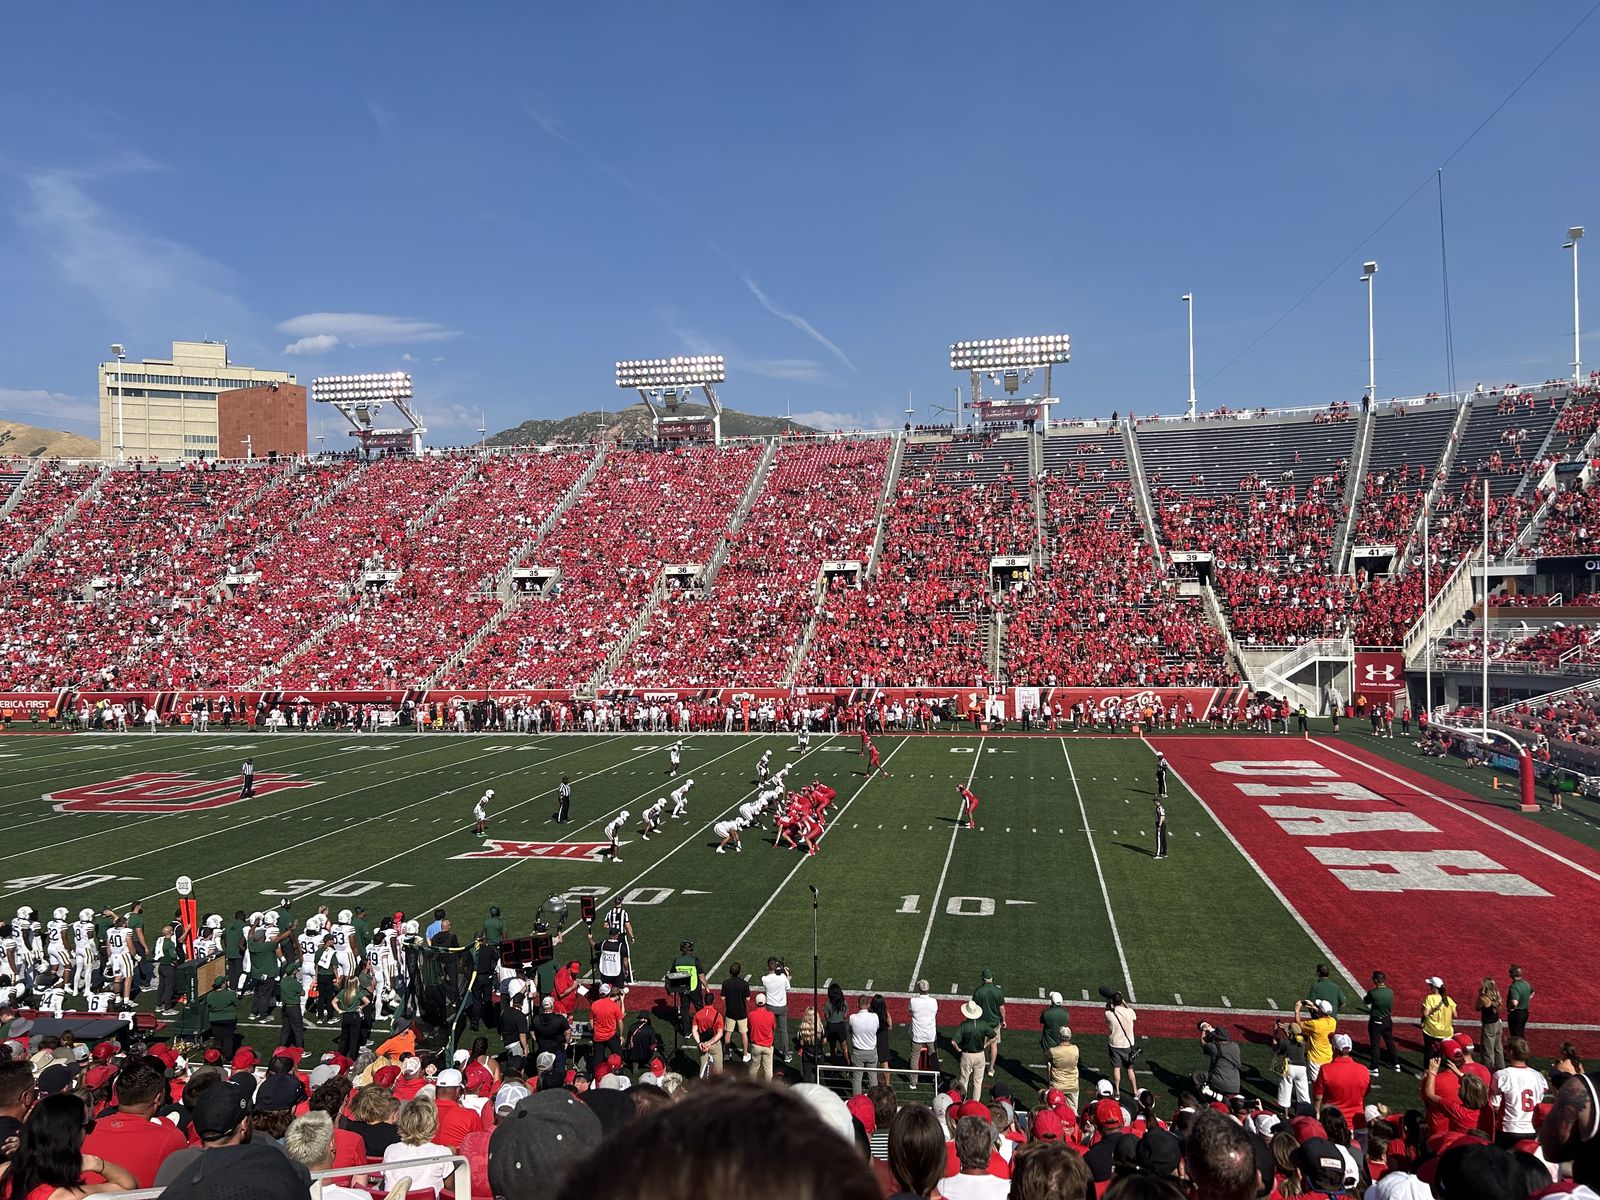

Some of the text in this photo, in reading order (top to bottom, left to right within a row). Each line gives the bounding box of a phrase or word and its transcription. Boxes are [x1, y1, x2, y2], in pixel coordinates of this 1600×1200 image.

[1005, 558, 1016, 566] 38
[25, 700, 51, 708] FIRST
[1209, 760, 1555, 897] UTAH
[3, 873, 118, 891] 40
[260, 879, 384, 898] 30
[558, 885, 676, 905] 20
[895, 894, 996, 916] 10
[109, 934, 123, 948] 40
[90, 996, 100, 1011] 6
[1521, 1089, 1534, 1112] 6
